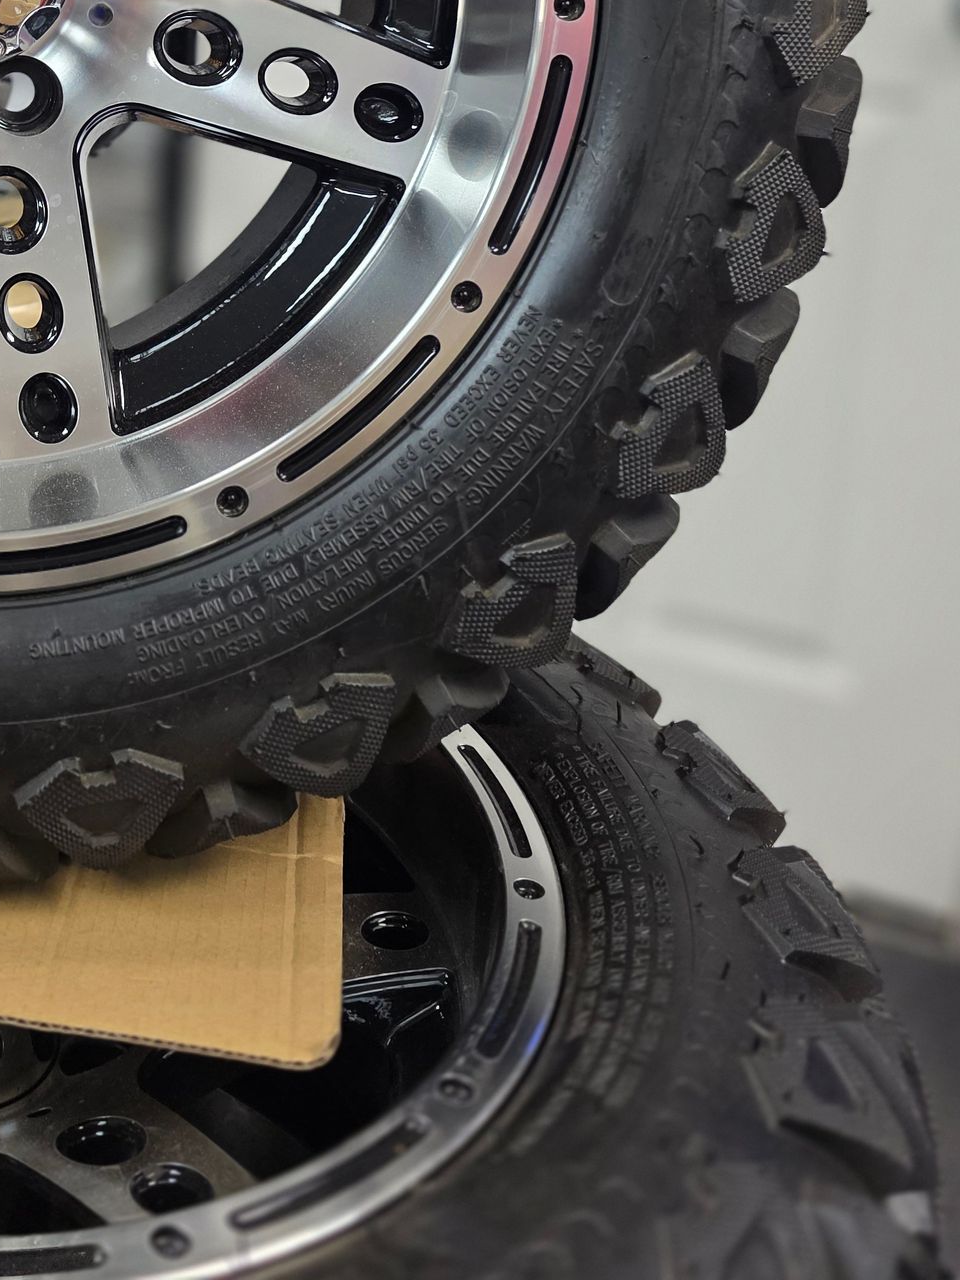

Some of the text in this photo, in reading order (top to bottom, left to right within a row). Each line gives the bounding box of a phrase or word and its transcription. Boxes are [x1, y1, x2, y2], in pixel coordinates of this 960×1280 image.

[537, 336, 605, 422] SAFETY
[458, 415, 487, 444] OF
[485, 379, 547, 449] FAILURE
[191, 305, 543, 598] NEVER EXCEED 35 psi WHEN SEATING BEADS.
[453, 445, 491, 483] DUE
[455, 419, 546, 513] WARNING:
[427, 480, 455, 507] TO
[300, 503, 391, 572] ASSEMBLY
[376, 515, 449, 576] SERIOUS
[228, 582, 256, 606] TO
[259, 561, 299, 593] DUE
[316, 569, 376, 614] INJURY
[131, 595, 225, 640] IMPROPER
[271, 607, 309, 637] MAY
[28, 626, 125, 659] MOUNTING
[192, 628, 265, 669] RESULT
